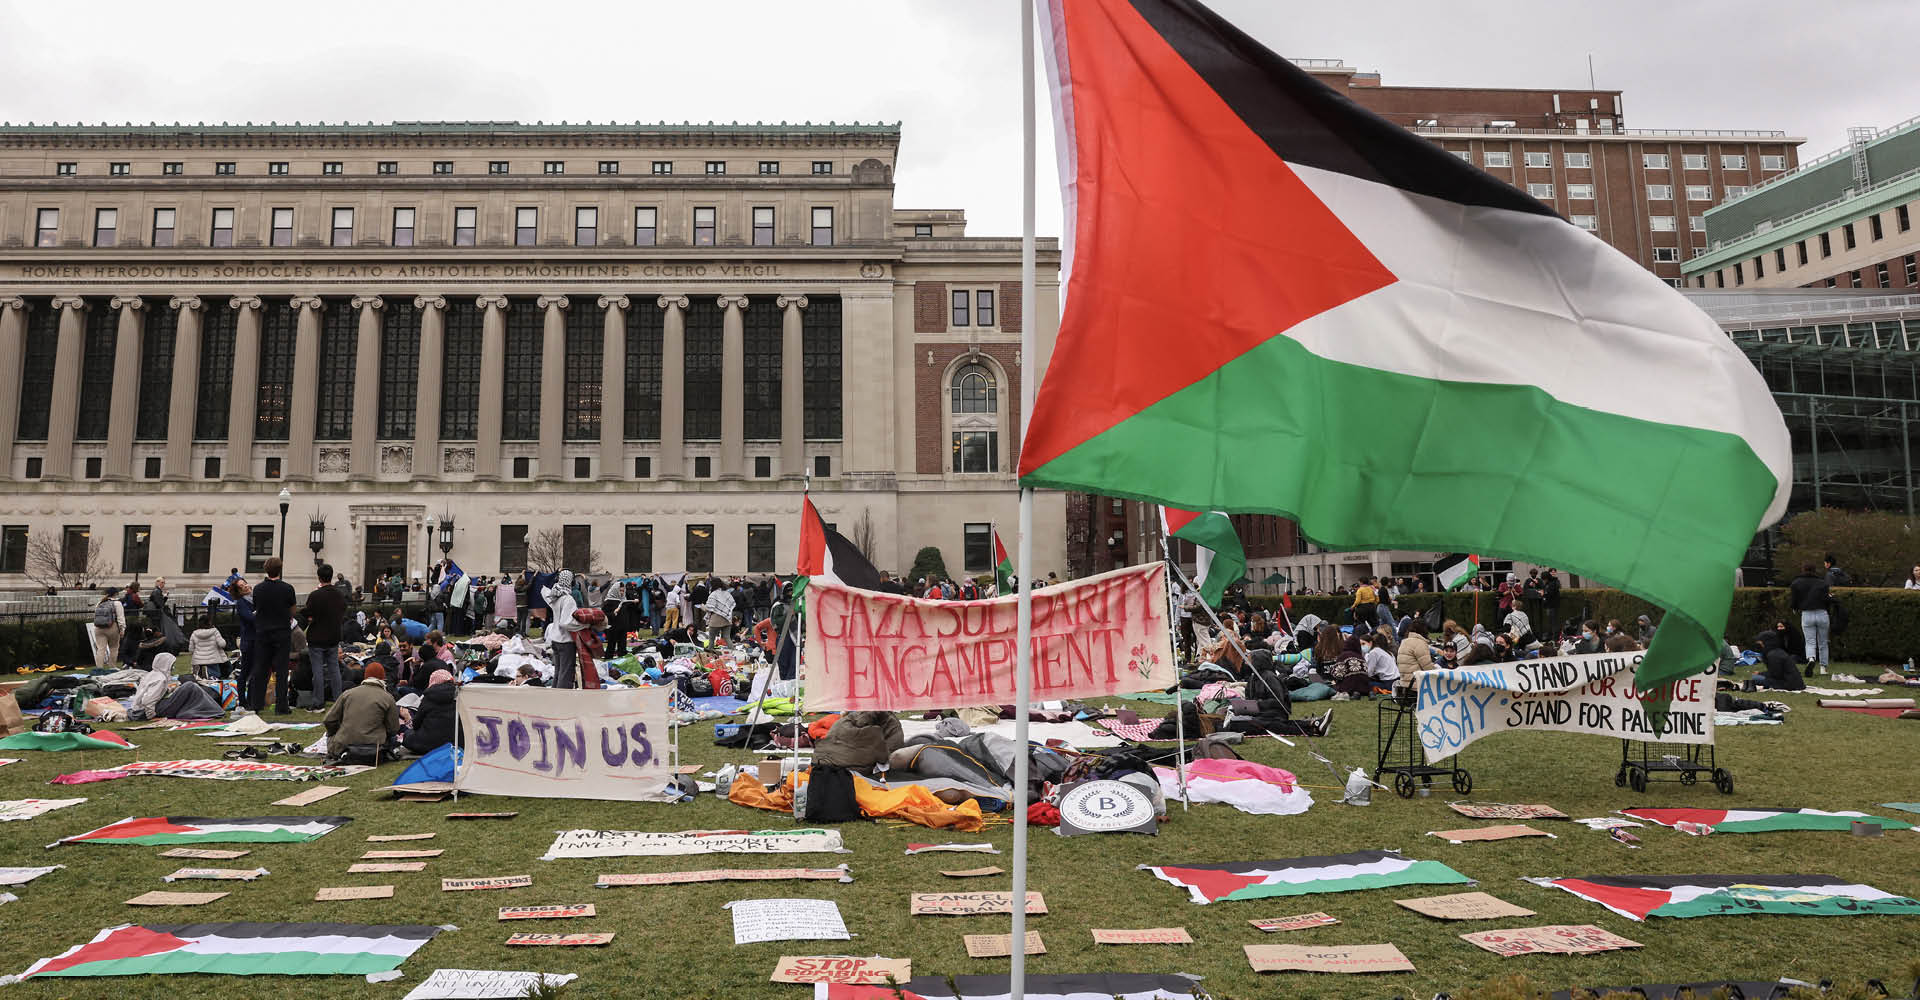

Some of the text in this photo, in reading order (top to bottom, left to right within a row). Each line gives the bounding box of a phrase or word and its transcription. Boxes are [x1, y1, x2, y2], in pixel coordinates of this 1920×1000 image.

[22, 265, 782, 279] HOMER HERODOTUS SOPHOCLES PLATO ARISTOTLE DEMOSTHENES CICERO VERGIL
[817, 565, 1165, 639] GAZA SOLDARITY
[846, 627, 1125, 700] ENCAMPMENT
[1417, 669, 1509, 711] ALUMNI
[1516, 662, 1578, 694] STAND
[1583, 655, 1627, 681] WITH
[1506, 700, 1572, 727] STAND
[1578, 702, 1615, 731] FOR
[475, 715, 660, 777] JOIN US.
[1099, 797, 1117, 810] B
[918, 893, 1009, 902] CANCEL
[511, 932, 572, 940] JUST
[794, 959, 867, 973] STOP
[784, 969, 891, 979] BOMBING
